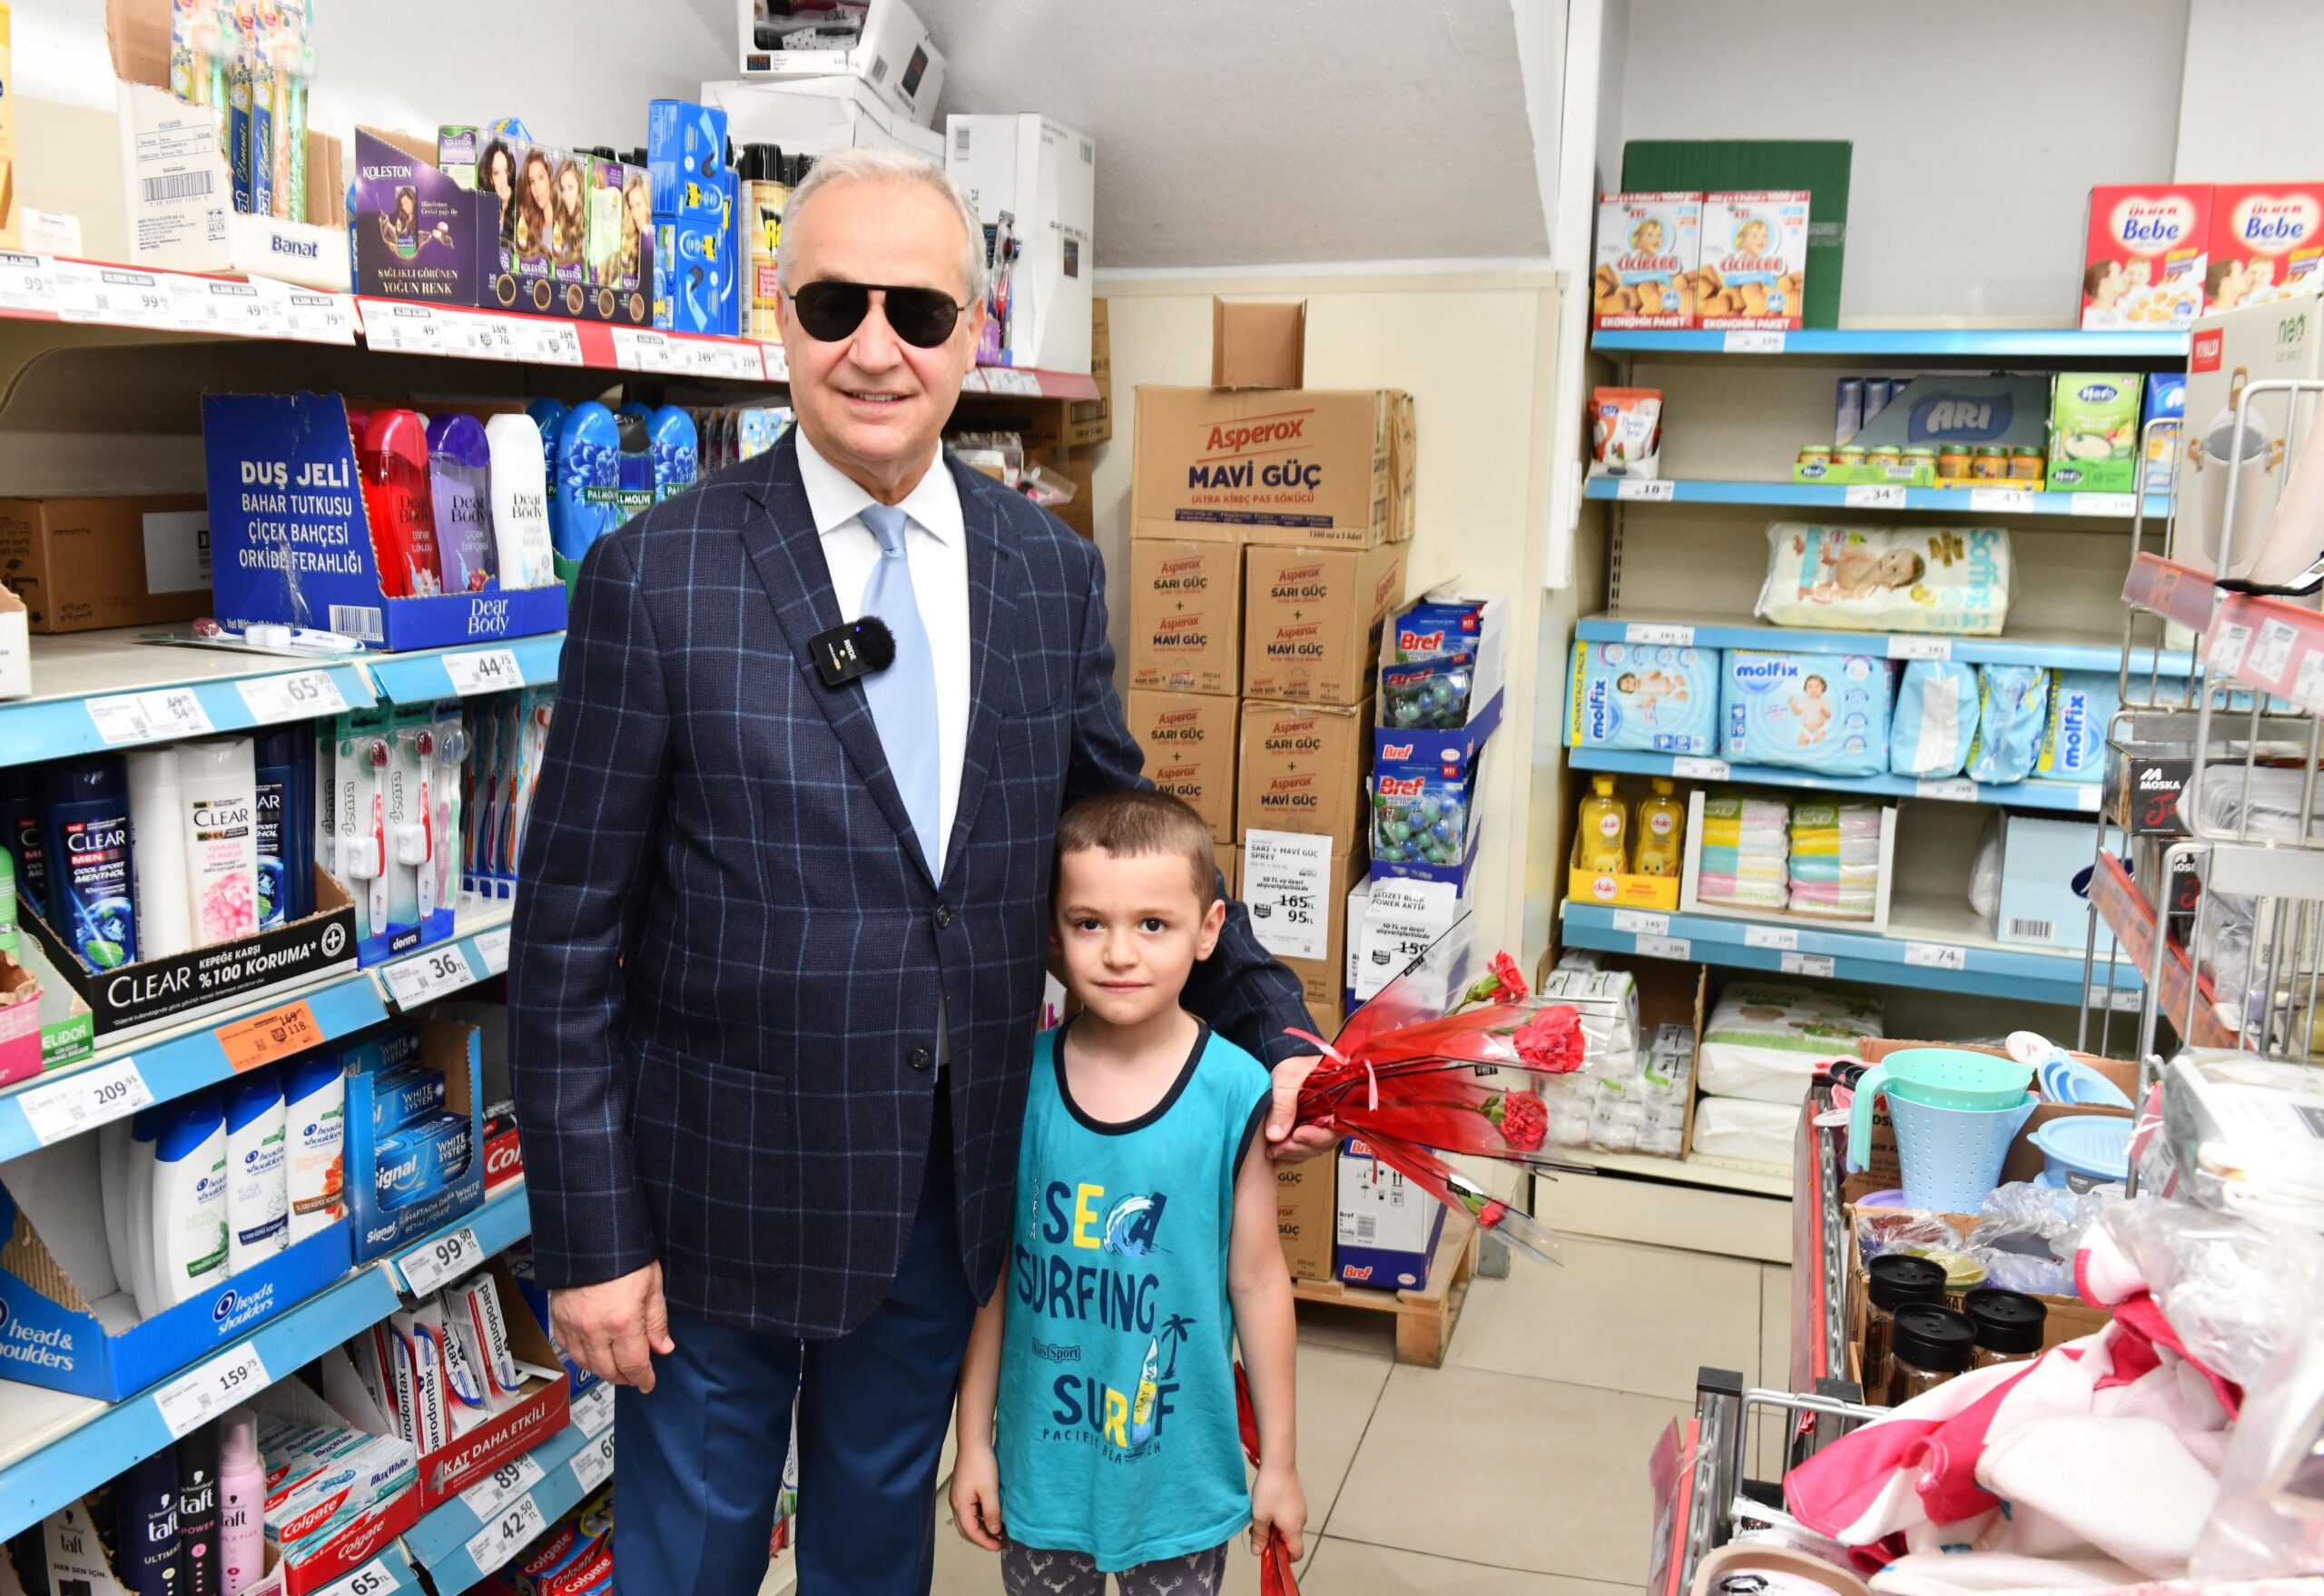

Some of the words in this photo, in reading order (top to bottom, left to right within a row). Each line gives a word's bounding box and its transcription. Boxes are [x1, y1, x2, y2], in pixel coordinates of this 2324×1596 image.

[363, 166, 411, 179] KOLESTON
[2122, 217, 2179, 241] Bebe
[2244, 216, 2304, 239] Bebe
[271, 234, 319, 258] Banat
[378, 267, 416, 278] SAĞLIKLI
[418, 268, 458, 280] GÖRÜNEN
[383, 281, 419, 293] YOĞUN
[421, 282, 452, 295] RENK
[1600, 316, 1653, 328] EKONOMİK
[1654, 316, 1687, 328] PAKET
[1703, 318, 1756, 330] EKONOMİK
[1756, 318, 1790, 330] PAKET
[2078, 387, 2118, 402] Hero
[1926, 399, 1992, 433] ARI
[1206, 419, 1304, 452] Asperox
[241, 460, 288, 490] DUŞ
[296, 458, 350, 488] JELİ
[1188, 460, 1253, 489] MAVİ
[1262, 459, 1323, 490] GÜÇ
[1801, 464, 1827, 478] Hero
[2053, 470, 2083, 481] Hero
[452, 495, 485, 507] Dear
[514, 493, 542, 506] Dear
[1191, 493, 1221, 504] ULTRA
[1224, 492, 1250, 506] KİREÇ
[1253, 494, 1271, 503] PAS
[1274, 491, 1315, 503] SÖKÜCÜ
[1873, 489, 1891, 500] 34
[242, 494, 287, 515] BAHAR
[290, 495, 352, 517] TUTKUSU
[512, 506, 543, 522] Body
[451, 507, 487, 527] Body
[249, 517, 287, 543] ÇİÇEK
[291, 521, 349, 547] BAHÇESİ
[239, 546, 288, 569] ORKİDE
[291, 549, 362, 574] FERAHLIĞI
[1161, 559, 1201, 574] Asperox
[1154, 578, 1180, 589] SARI
[1183, 576, 1207, 590] GÜÇ
[1279, 567, 1320, 582] Asperox
[1271, 586, 1298, 597] SARI
[1302, 585, 1327, 598] GÜÇ
[471, 598, 509, 616] Dear
[468, 616, 510, 636] Body
[1159, 616, 1199, 631] Asperox
[1276, 625, 1317, 640] Asperox
[1153, 634, 1180, 645] MAVİ
[1183, 633, 1207, 646] GÜÇ
[1400, 631, 1444, 652] Bref
[1267, 643, 1295, 655] MAVİ
[1298, 643, 1324, 656] GÜÇ
[1577, 650, 1587, 675] PACK
[1736, 661, 1799, 678] molfix
[1387, 668, 1433, 687] Bref
[1573, 675, 1584, 734] ADVANTAGE
[1590, 679, 1607, 740] molfix
[1158, 712, 1198, 725] Asperox
[1273, 720, 1315, 734] Asperox
[1151, 729, 1177, 740] SARI
[1180, 729, 1204, 741] GÜÇ
[2064, 694, 2086, 768] molfix
[1265, 739, 1293, 750] SARI
[1295, 737, 1321, 750] GÜÇ
[1383, 744, 1413, 760] Bref
[1157, 766, 1196, 781] Asperox
[1157, 783, 1175, 796] AVİ
[1177, 784, 1202, 796] GÜÇ
[1271, 776, 1312, 792] Asperox
[1379, 776, 1425, 796] Bref
[2140, 780, 2181, 790] MOSKA
[1261, 793, 1289, 806] MAVİ
[1292, 793, 1318, 806] GÜÇ
[193, 808, 249, 827] CLEAR
[67, 830, 126, 852] CLEAR
[72, 852, 103, 865] MEN
[1250, 852, 1275, 861] SPREY
[1251, 843, 1270, 852] SARI
[1280, 846, 1300, 856] MAVİ
[1302, 848, 1319, 859] GÜÇ
[74, 866, 97, 876] COOL
[98, 862, 125, 872] SPORT
[74, 869, 125, 883] MENTHOL
[1593, 881, 1617, 893] dalin
[1279, 894, 1307, 908] 165
[1372, 898, 1400, 909] POWER
[1402, 900, 1426, 911] AKTİF
[1288, 911, 1307, 923] 95
[1409, 925, 1425, 933] üzeri
[199, 951, 233, 970] KEPEĞE
[234, 944, 261, 961] KARŞI
[1936, 948, 1955, 963] 74
[429, 953, 457, 979] 36
[199, 964, 241, 990] %100
[107, 966, 192, 1009] CLEAR
[380, 1037, 409, 1055] WHITE
[382, 1047, 409, 1065] SYSTEM
[402, 1083, 433, 1103] WHITE
[404, 1094, 434, 1113] SYSTEM
[436, 1132, 466, 1154] WHITE
[438, 1143, 467, 1163] SYSTEM
[246, 1153, 284, 1174] shoulders
[1277, 1170, 1303, 1184] GÜÇ
[456, 1181, 480, 1199] WHITE
[1042, 1181, 1167, 1250] SEA
[367, 1221, 396, 1245] Signal
[1343, 1264, 1373, 1280] Bref
[1015, 1243, 1160, 1335] SURFING
[218, 1296, 273, 1336] shoulders
[478, 1284, 506, 1360] parodontax
[0, 1342, 74, 1372] oulders
[1053, 1374, 1180, 1449] SURF
[427, 1459, 447, 1496] 4
[443, 1451, 468, 1475] KAT
[472, 1429, 508, 1459] DAHA
[511, 1403, 546, 1433] ETKİLİ
[181, 1488, 214, 1515] taft
[148, 1511, 179, 1542] taft
[283, 1498, 338, 1538] Colgate
[182, 1520, 215, 1535] POWER
[60, 1534, 84, 1555] taft
[338, 1519, 385, 1560] Colgate
[525, 1533, 572, 1573] Colgate
[54, 1562, 71, 1572] HER
[72, 1564, 88, 1575] SEN
[565, 1557, 612, 1593] Colgate
[351, 1571, 379, 1596] 65
